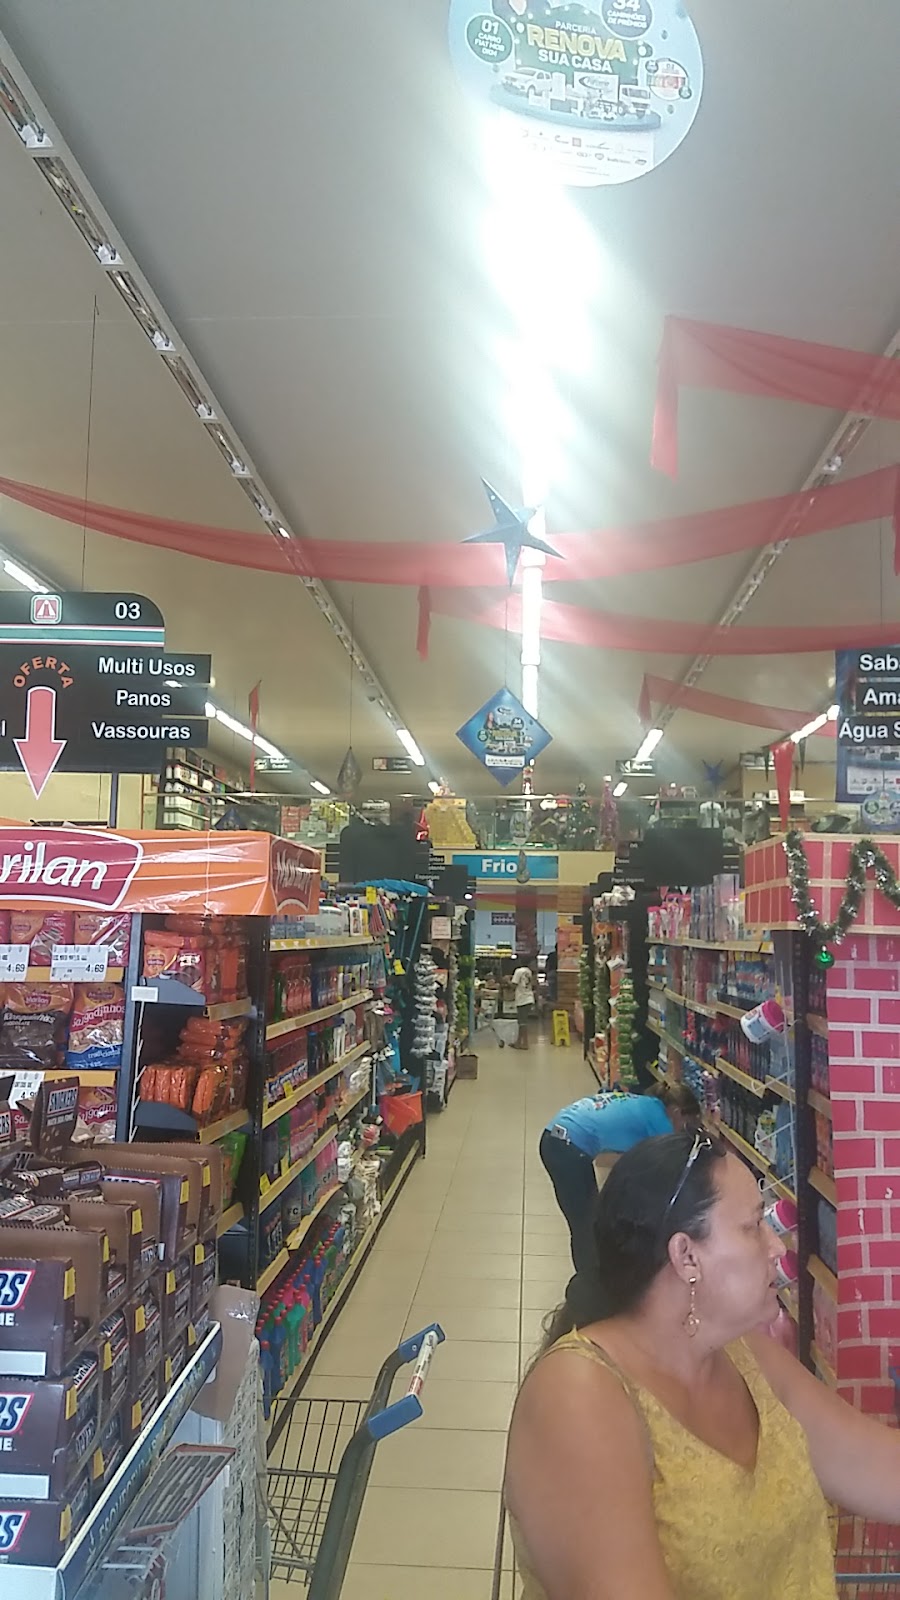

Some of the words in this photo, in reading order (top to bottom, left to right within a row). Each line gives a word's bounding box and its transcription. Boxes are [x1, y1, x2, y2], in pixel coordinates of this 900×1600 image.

[481, 19, 499, 35] 01
[555, 20, 597, 34] PARCERIA
[526, 23, 627, 63] RENOVA
[538, 49, 569, 66] SUA
[571, 56, 613, 74] CASA
[114, 602, 141, 620] 03
[13, 656, 75, 688] OFERTA
[98, 656, 143, 675] Multi
[149, 658, 196, 676] Usos
[859, 653, 900, 672] Sab
[116, 689, 171, 707] Panos
[91, 721, 191, 740] Vassouras
[839, 718, 888, 743] Água
